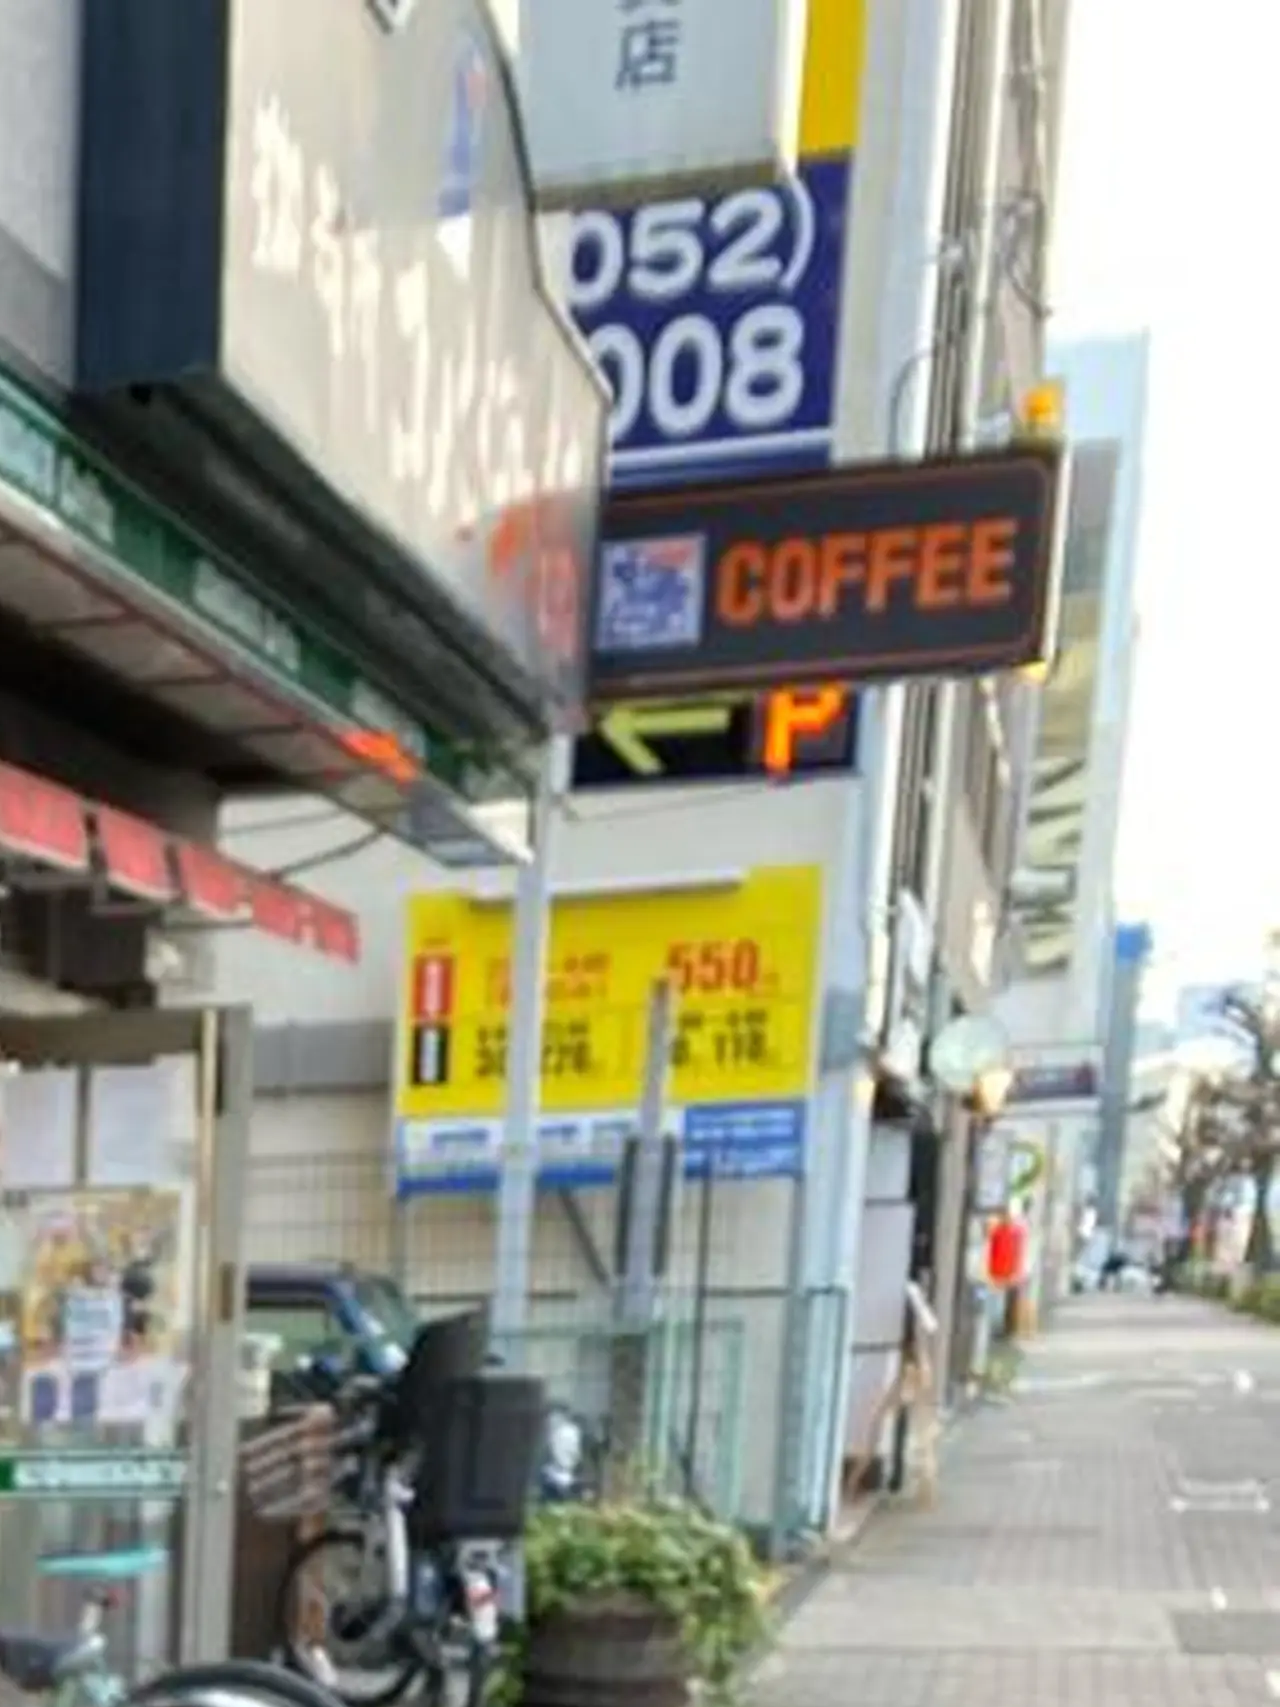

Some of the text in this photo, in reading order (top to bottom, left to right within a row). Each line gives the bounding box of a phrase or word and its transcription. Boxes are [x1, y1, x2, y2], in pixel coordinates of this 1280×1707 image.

[615, 0, 682, 89] 店
[717, 518, 1017, 625] COFFEE
[762, 682, 844, 774] P
[668, 938, 758, 993] 550
